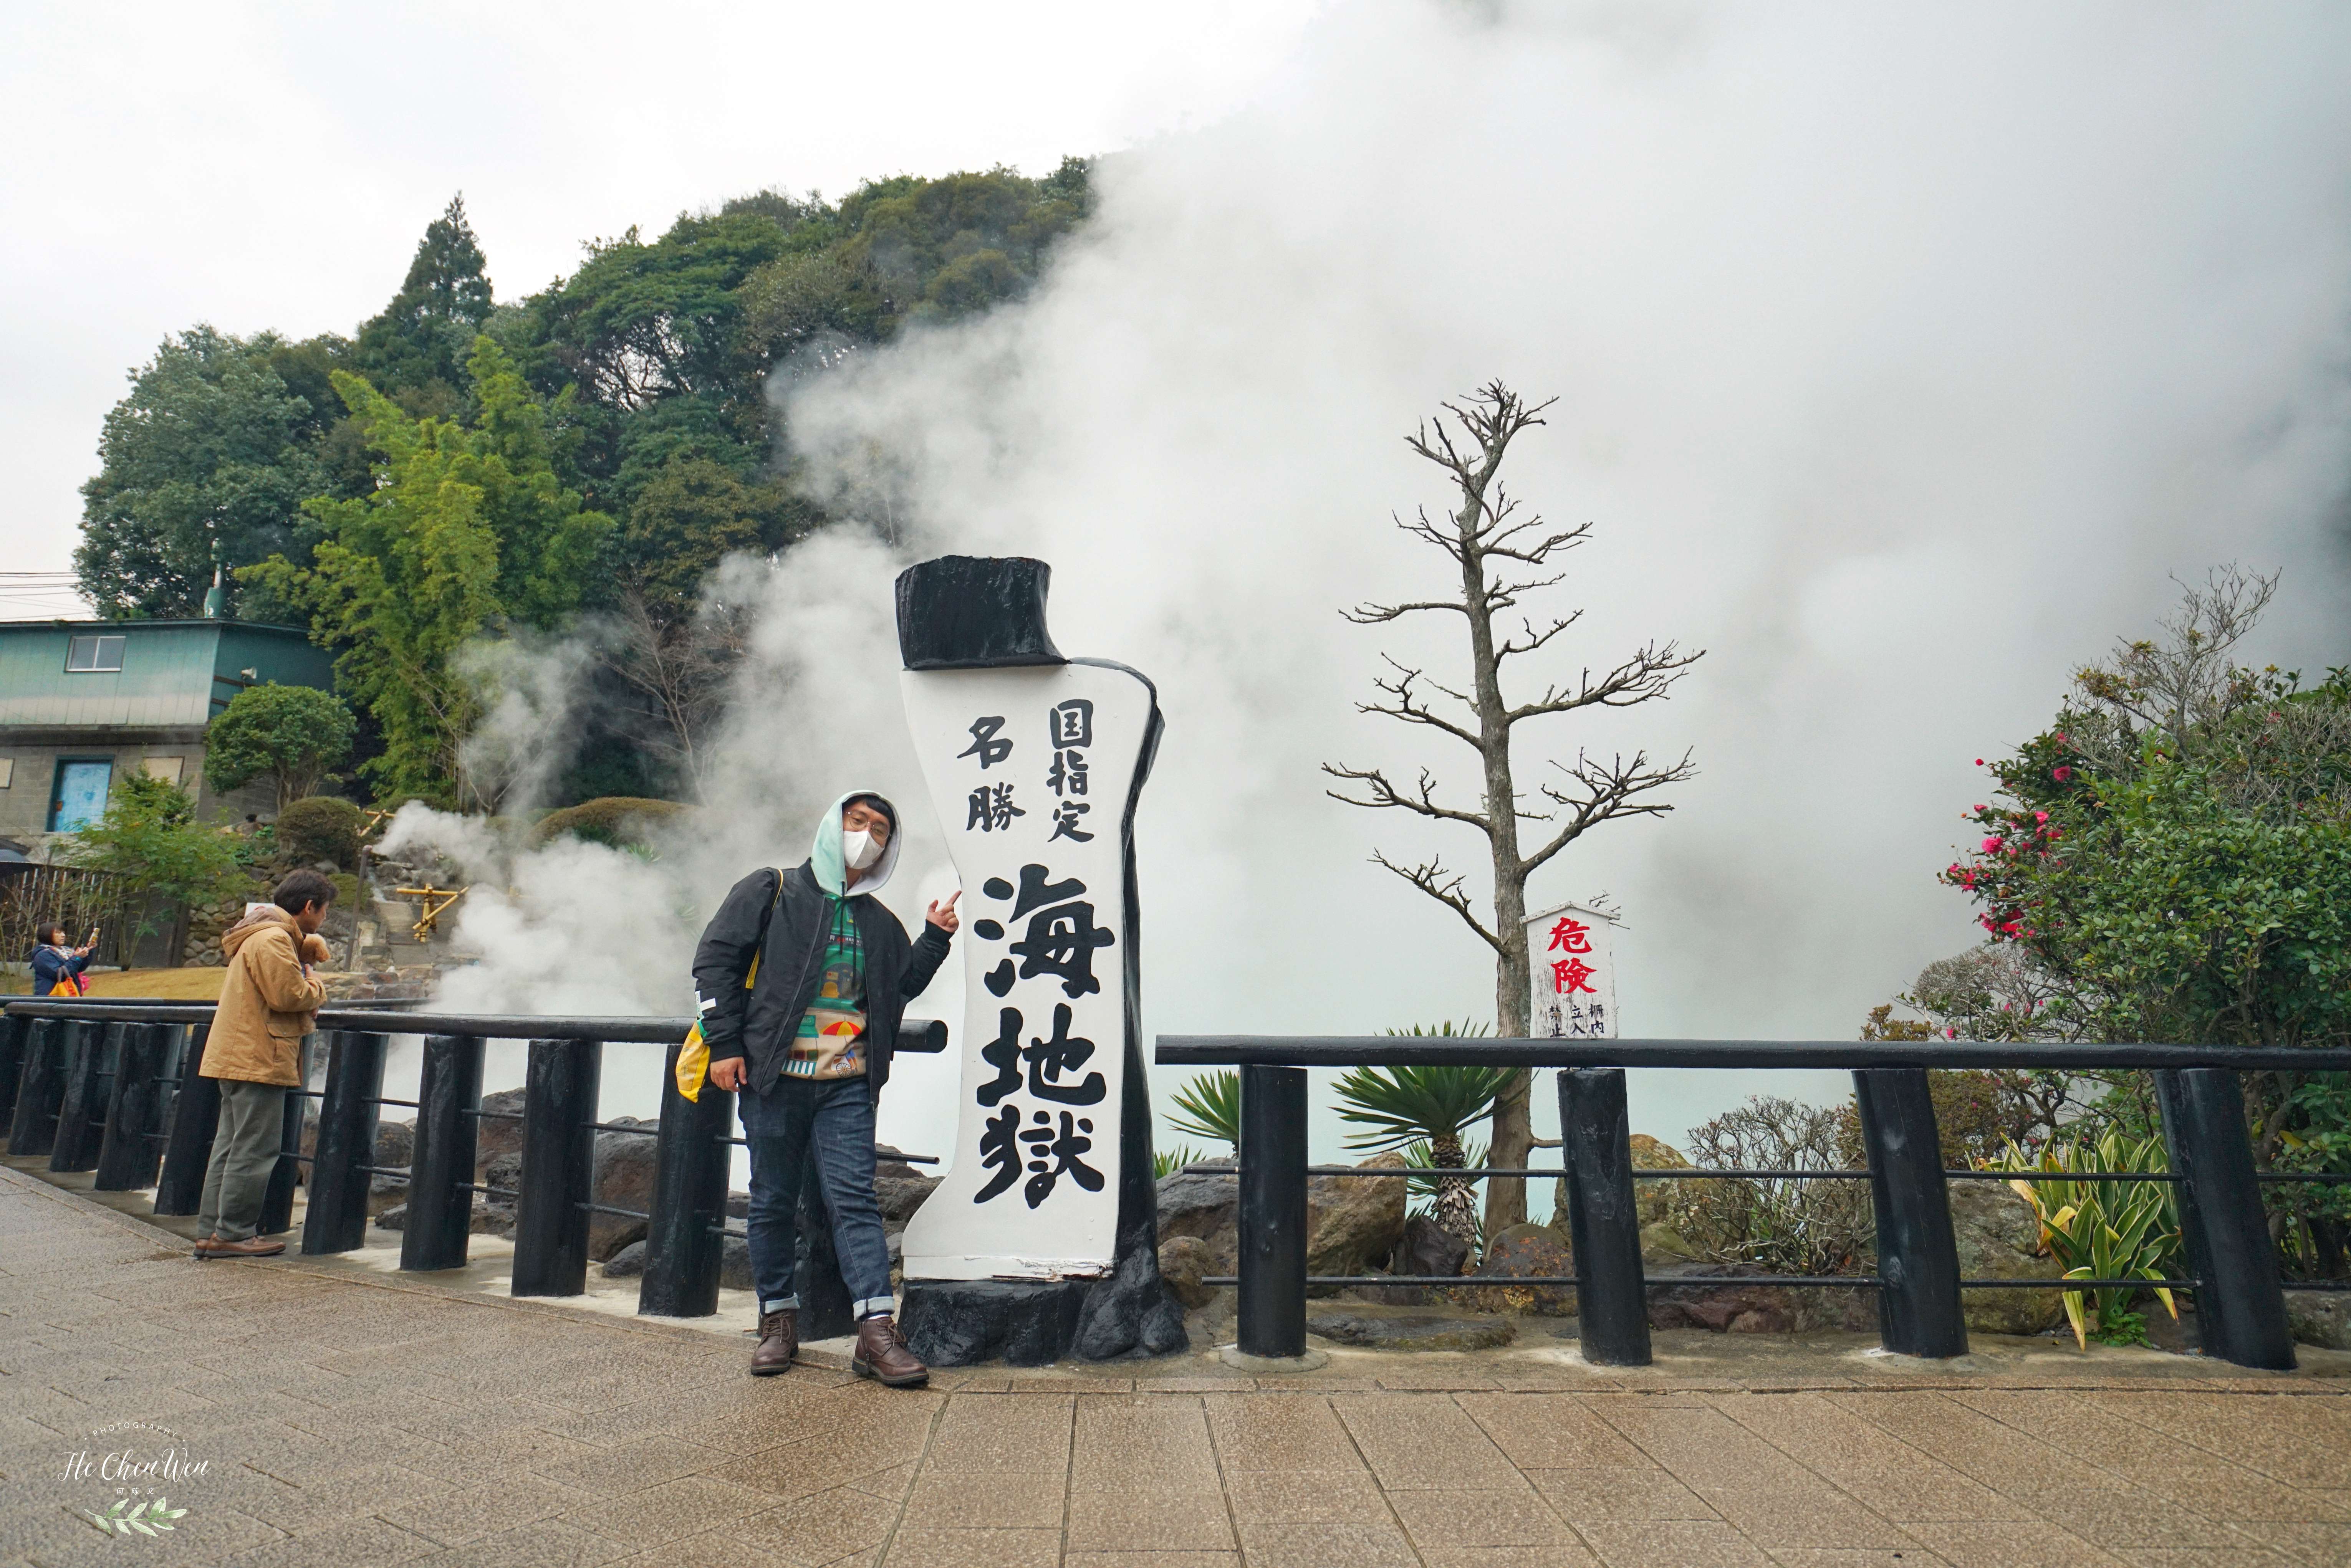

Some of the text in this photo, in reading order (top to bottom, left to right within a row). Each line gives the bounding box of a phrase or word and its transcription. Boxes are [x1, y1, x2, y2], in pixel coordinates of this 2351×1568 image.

[957, 716, 1026, 832] 名勝
[1046, 699, 1094, 843] 国指定
[1548, 916, 1598, 994] 危険
[974, 863, 1115, 1209] 海地獄
[1549, 1005, 1566, 1037] 禁止
[1571, 1004, 1586, 1034] 立入
[1588, 1003, 1604, 1034] 柵内
